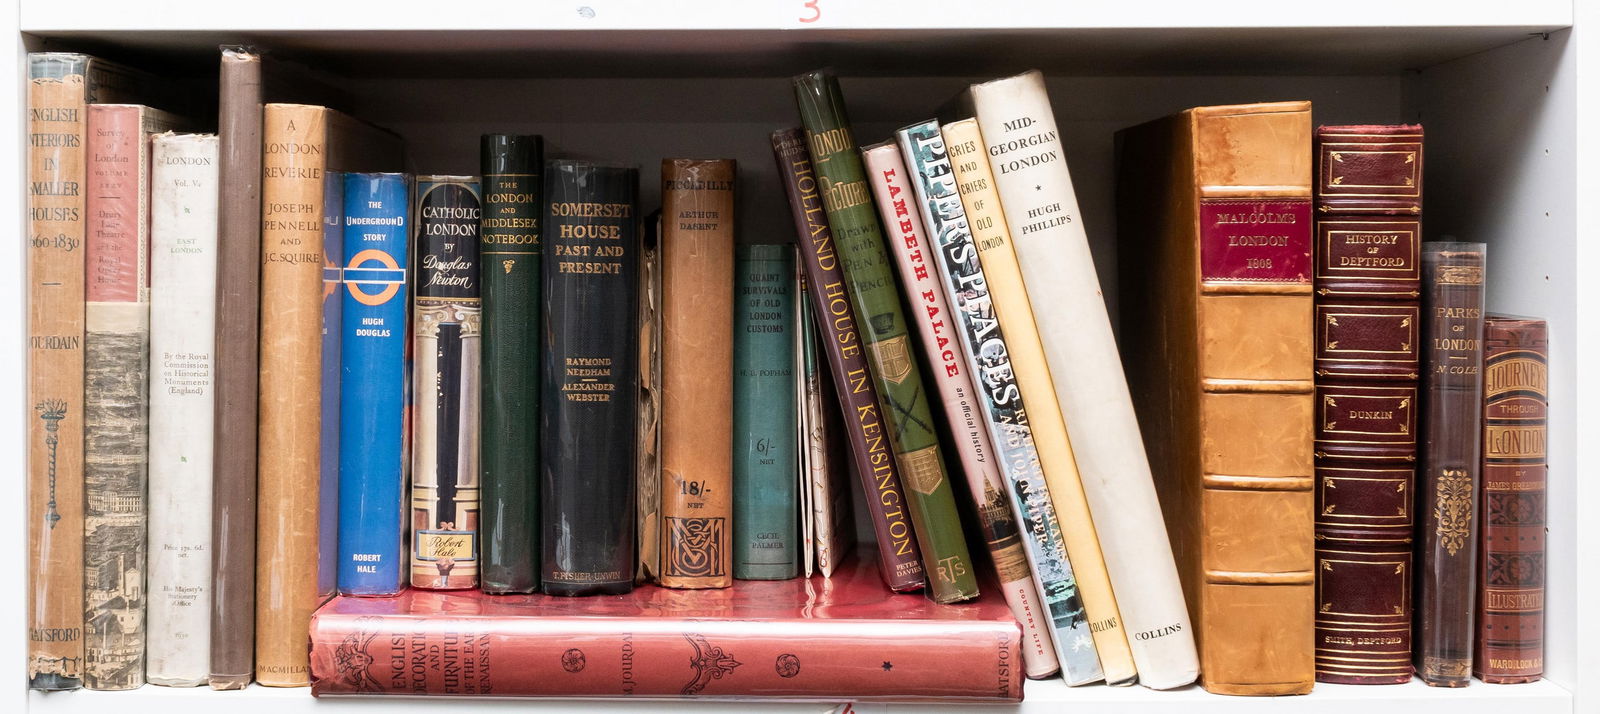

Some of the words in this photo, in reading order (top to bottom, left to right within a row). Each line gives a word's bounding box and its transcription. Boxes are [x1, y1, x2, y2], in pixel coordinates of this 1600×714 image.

[287, 119, 296, 131] A
[1004, 116, 1037, 133] MID-
[264, 143, 320, 155] LONDON
[949, 140, 977, 158] CRIES
[989, 130, 1057, 157] GEORGIAN
[43, 157, 57, 171] IN
[95, 154, 129, 163] London
[166, 157, 211, 166] LONDON
[1000, 150, 1058, 175] LONDON
[959, 161, 978, 174] AND
[264, 168, 320, 179] REVERIE
[665, 180, 733, 191] PICCADILLY
[960, 178, 988, 195] CRIERS
[487, 193, 533, 203] LONDON
[269, 203, 314, 216] JOSEPH
[368, 201, 382, 209] THE
[551, 202, 631, 218] SOMERSET
[974, 200, 985, 211] OF
[1027, 202, 1061, 219] HUGH
[423, 206, 480, 219] CATHOLIC
[679, 211, 719, 219] ARTHUR
[791, 160, 837, 271] HOLLAND
[346, 216, 404, 227] UNDERGROUND
[482, 218, 536, 228] MIDDLESEX
[976, 216, 993, 230] OLD
[1021, 214, 1072, 235] PHILLIPS
[1216, 213, 1297, 225] MALCOLMS
[264, 221, 320, 232] PENNELL
[426, 223, 476, 237] LONDON
[560, 224, 620, 239] HOUSE
[679, 223, 718, 231] DASENT
[280, 238, 301, 246] AND
[363, 233, 387, 242] STORY
[482, 234, 539, 245] NOTEBOOK
[1228, 235, 1289, 248] LONDON
[1345, 234, 1398, 245] HISTORY
[444, 243, 455, 253] BY
[852, 240, 876, 252] with
[977, 235, 1005, 252] LONDON
[170, 247, 203, 255] LONDON
[555, 245, 590, 256] PAST
[594, 246, 624, 257] AND
[1366, 246, 1380, 254] OF
[423, 254, 472, 277] Douglas
[1340, 256, 1405, 267] DEPTFORD
[559, 261, 621, 274] PRESENT
[423, 272, 473, 290] Newton
[749, 273, 780, 283] QUAINT
[743, 286, 786, 295] SURVIVALS
[750, 299, 761, 308] OF
[764, 299, 781, 308] OLD
[750, 312, 782, 321] LONDON
[883, 168, 929, 281] LAMBETH
[922, 289, 960, 378] PALACE
[956, 387, 964, 398] an
[960, 400, 977, 429] official
[970, 431, 986, 464] history
[1436, 307, 1481, 319] PARKS
[362, 317, 384, 326] HUGH
[825, 282, 860, 359] HOUSE
[356, 328, 391, 338] DOUGLAS
[747, 324, 784, 334] CUSTOMS
[957, 266, 1020, 406] PLACES
[1434, 338, 1480, 351] LONDON
[188, 353, 209, 361] Royal
[566, 358, 611, 366] RAYMOND
[164, 361, 209, 369] Commission
[1449, 365, 1478, 375] COLE
[164, 378, 209, 386] Monuments
[562, 383, 615, 391] ALEXANDER
[847, 368, 870, 395] IN
[168, 386, 203, 396] (England)
[566, 393, 610, 402] WEBSTER
[1500, 404, 1539, 414] THROUGH
[1349, 411, 1393, 420] DUNKIN
[756, 438, 776, 455] 6/-
[1489, 429, 1545, 455] LONDON
[857, 404, 913, 556] KENSINGTON
[681, 480, 711, 497] 18/-
[430, 536, 465, 548] Robert
[353, 553, 382, 562] ROBERT
[431, 547, 457, 558] Hale
[357, 565, 377, 574] HALE
[896, 560, 918, 570] PETER
[896, 566, 922, 577] DAVIES
[1019, 589, 1036, 630] COUNTRY
[1032, 633, 1044, 656] LIFE
[1089, 616, 1118, 634] COLLINS
[1134, 622, 1182, 641] COLLINS
[1357, 637, 1402, 645] DEPTFORD
[430, 645, 440, 672] AND
[622, 632, 637, 686] JOURDAI
[463, 655, 475, 676] THE
